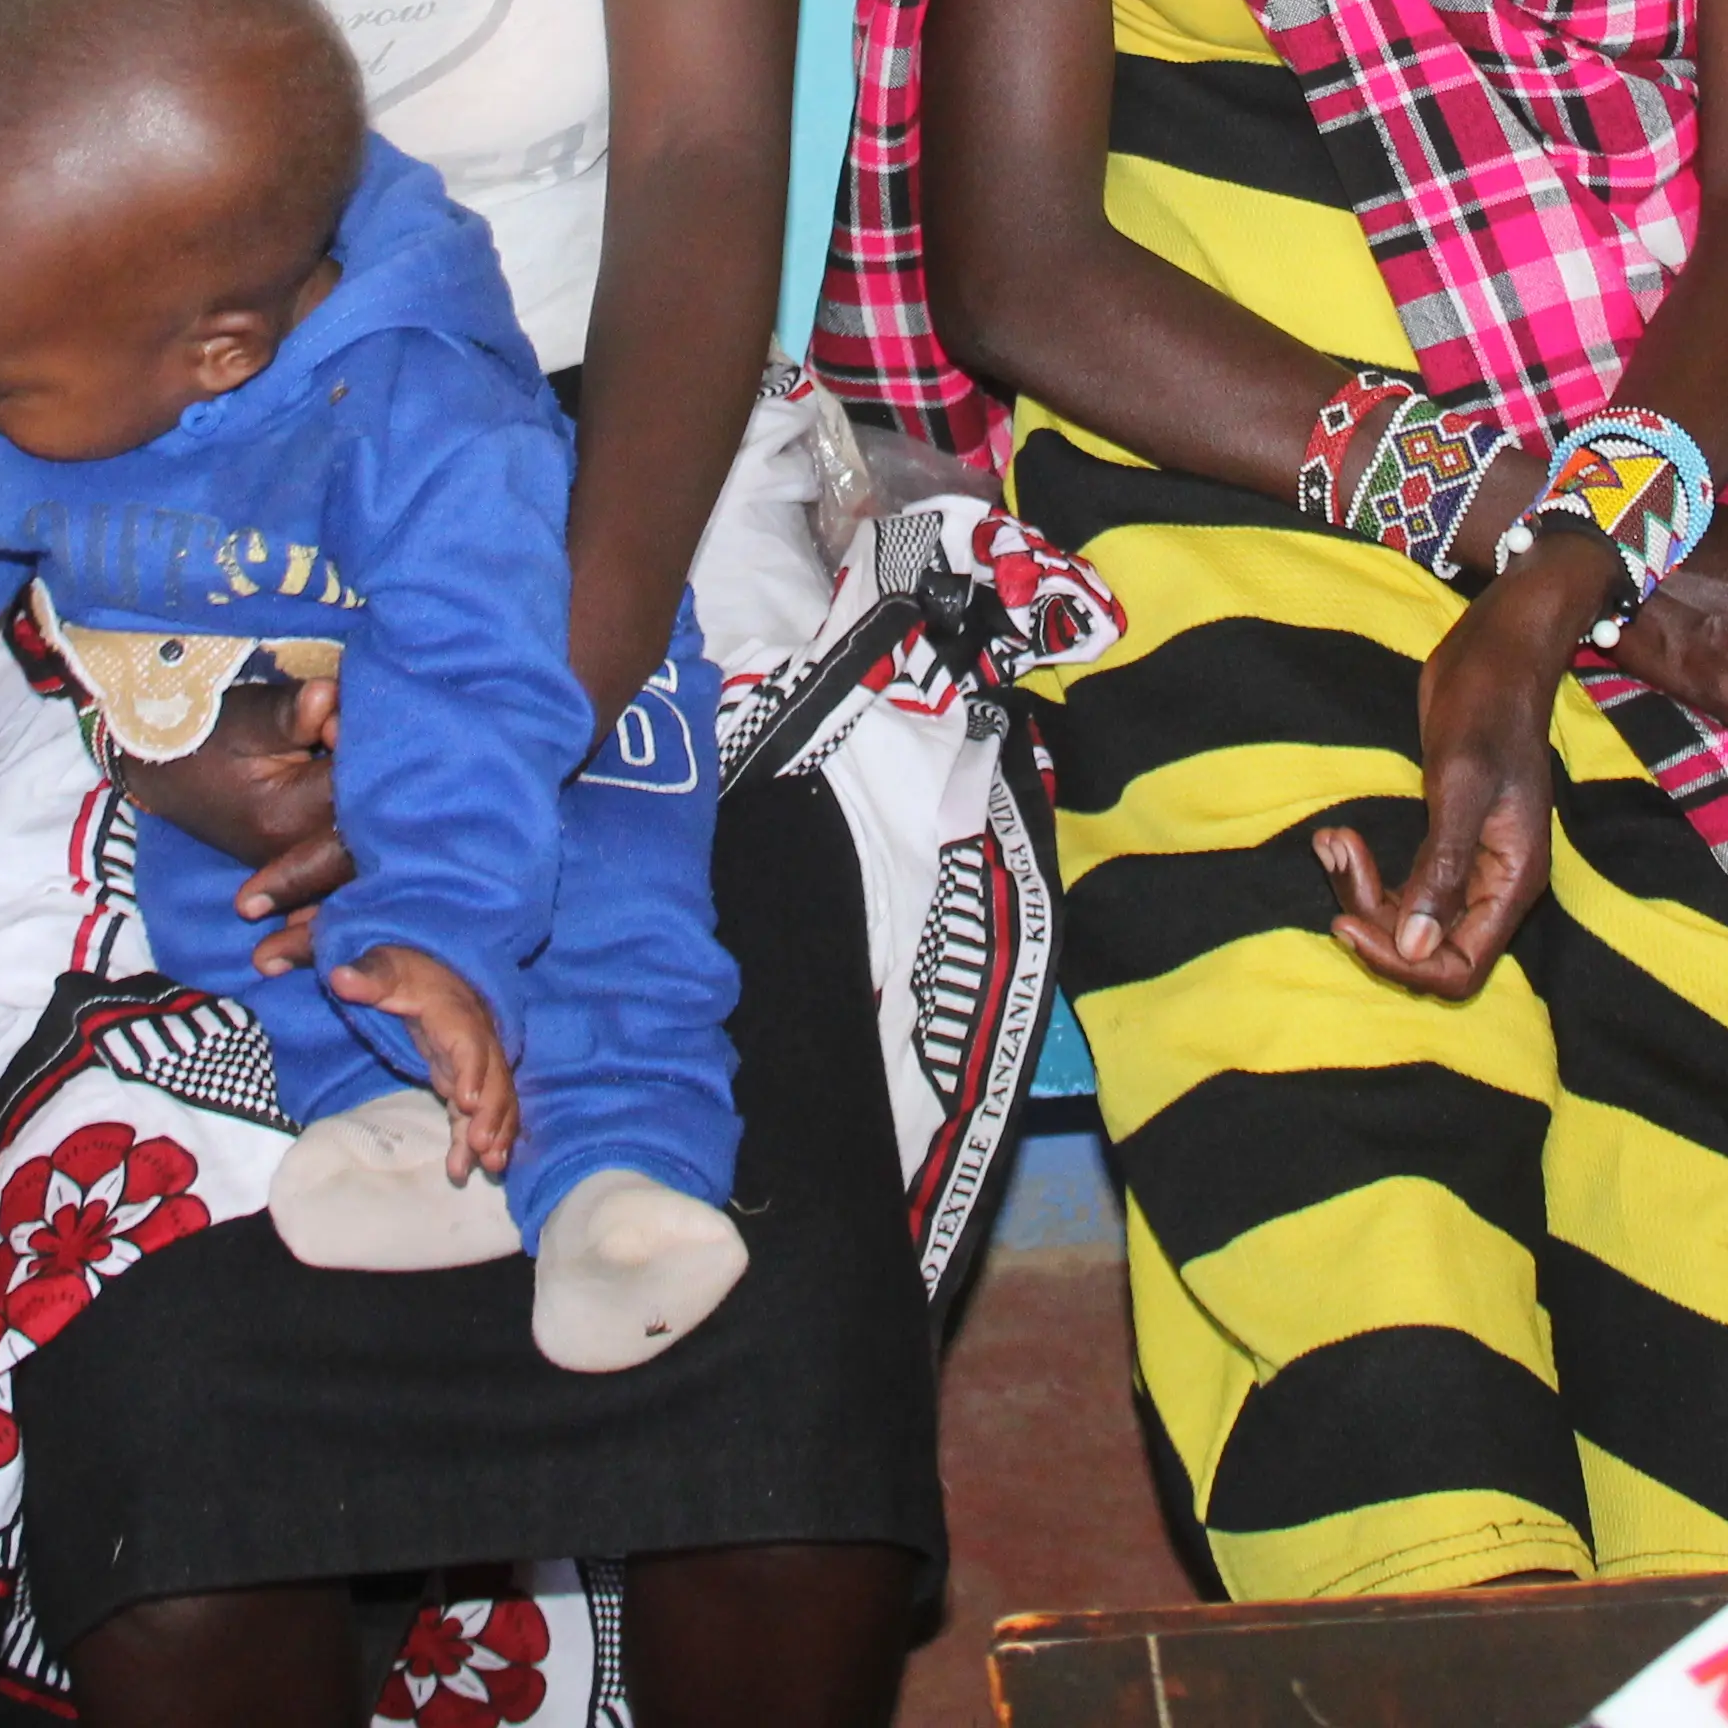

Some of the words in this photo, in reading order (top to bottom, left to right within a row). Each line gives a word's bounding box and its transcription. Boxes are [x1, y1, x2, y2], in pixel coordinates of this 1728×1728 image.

[336, 0, 436, 30] row
[1008, 841, 1047, 946] KHANGA
[981, 970, 1039, 1125] TANZANIA
[930, 1134, 991, 1256] TEXTILE
